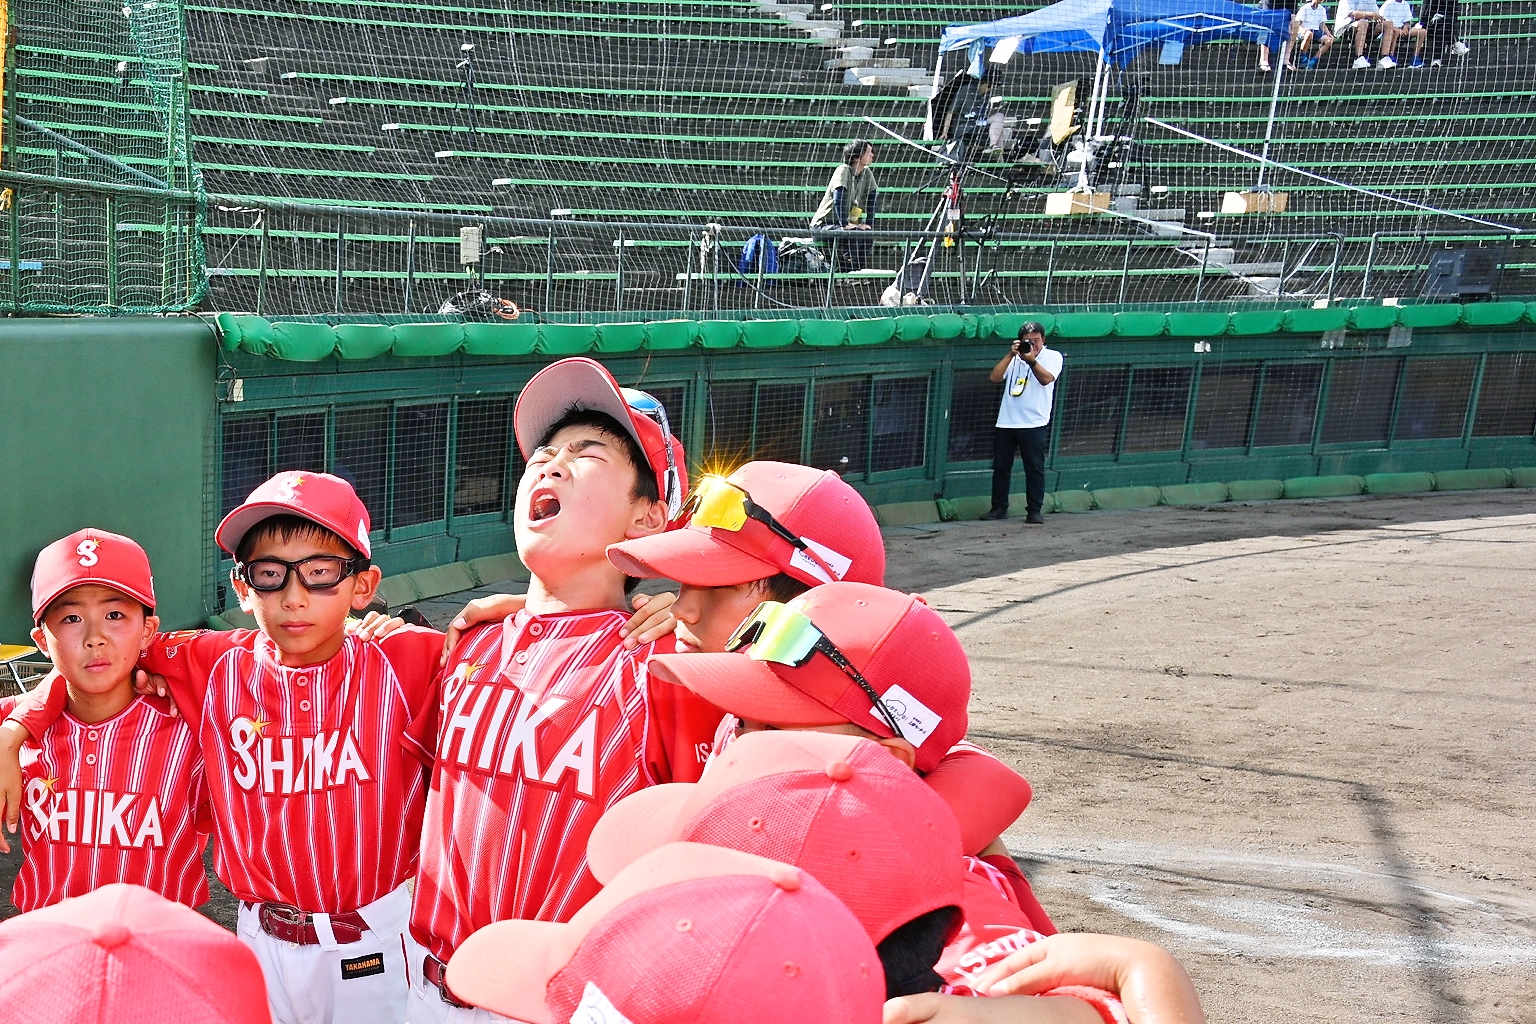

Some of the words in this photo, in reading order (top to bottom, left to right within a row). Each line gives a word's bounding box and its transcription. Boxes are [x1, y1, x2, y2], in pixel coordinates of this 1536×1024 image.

[229, 716, 371, 794] SHIKA
[24, 777, 164, 848] SHIKA
[344, 957, 381, 971] TAKAHAMA
